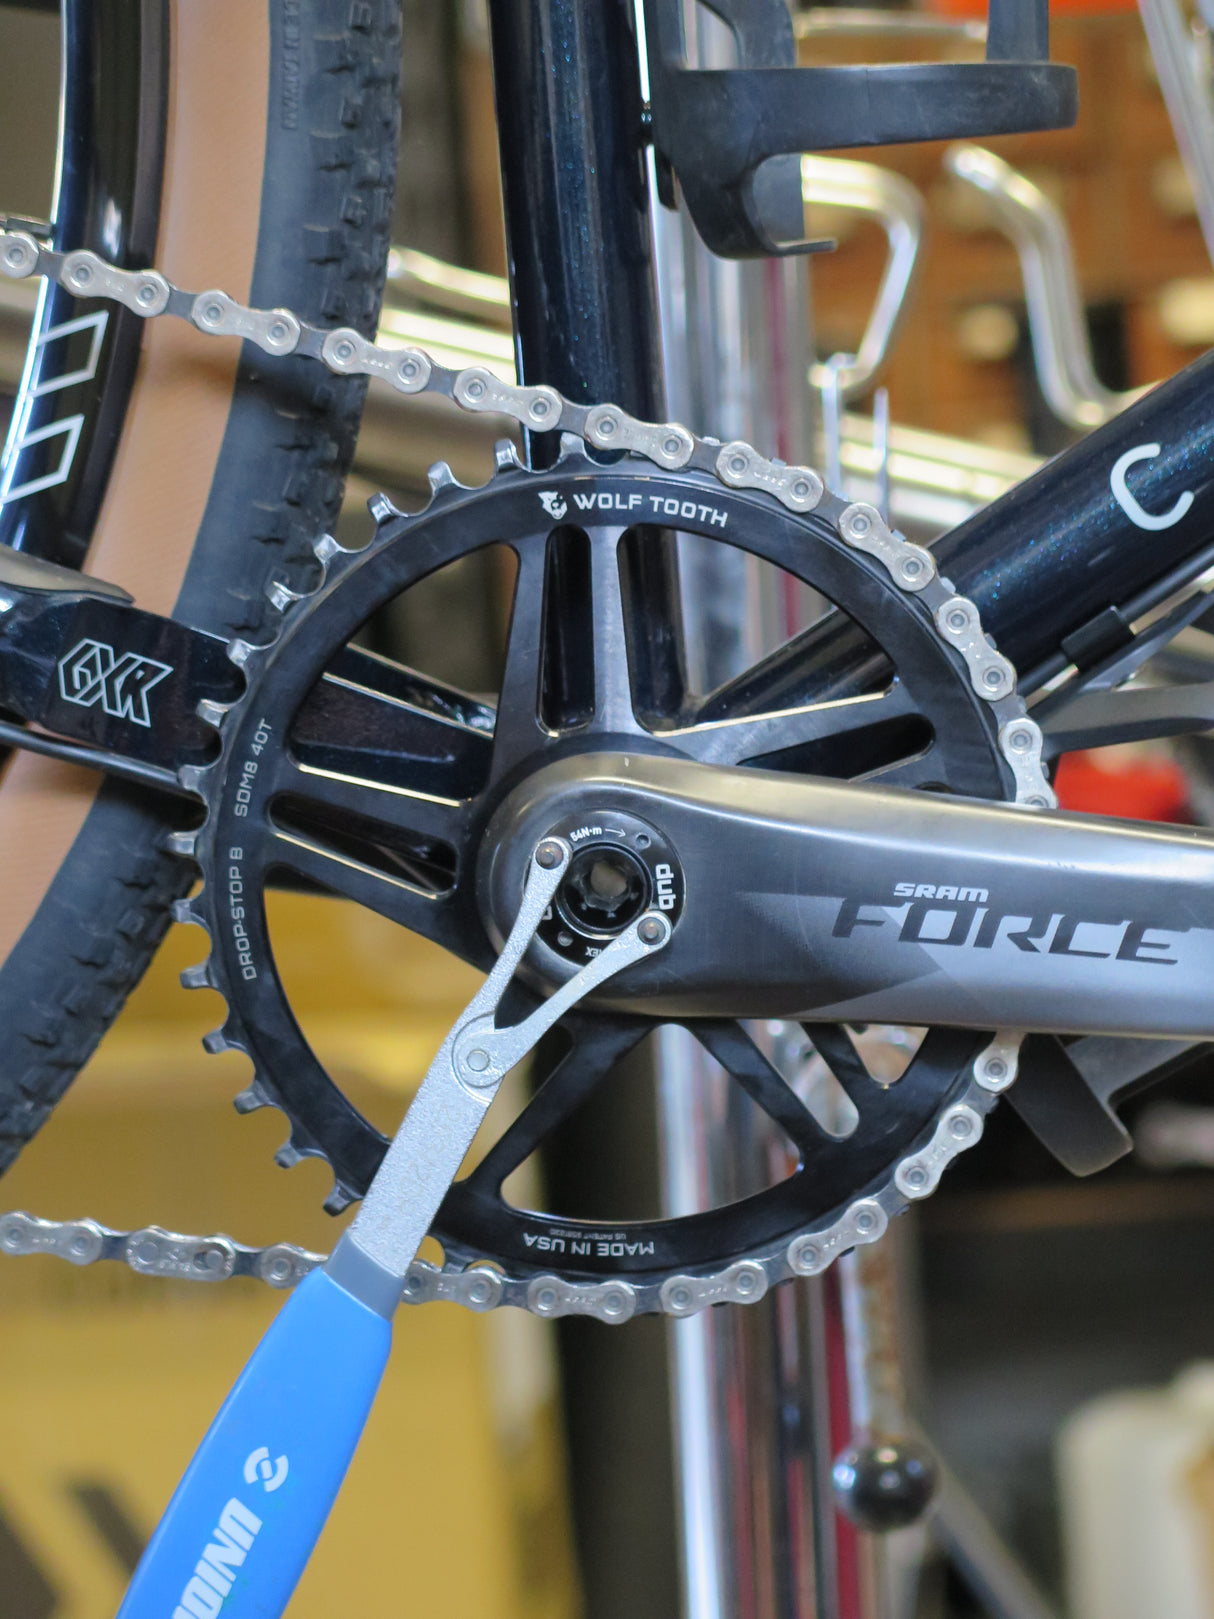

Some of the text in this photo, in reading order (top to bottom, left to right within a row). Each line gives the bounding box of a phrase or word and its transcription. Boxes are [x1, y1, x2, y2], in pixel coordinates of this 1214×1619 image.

[573, 493, 728, 528] WOLF TOOTH
[254, 718, 273, 756] 40T
[229, 847, 243, 860] B
[893, 882, 989, 903] SRAM
[831, 898, 1191, 965] FORCE
[585, 946, 605, 958] EX
[523, 1232, 655, 1256] MADE IN USA
[171, 1496, 263, 1619] UNIO
